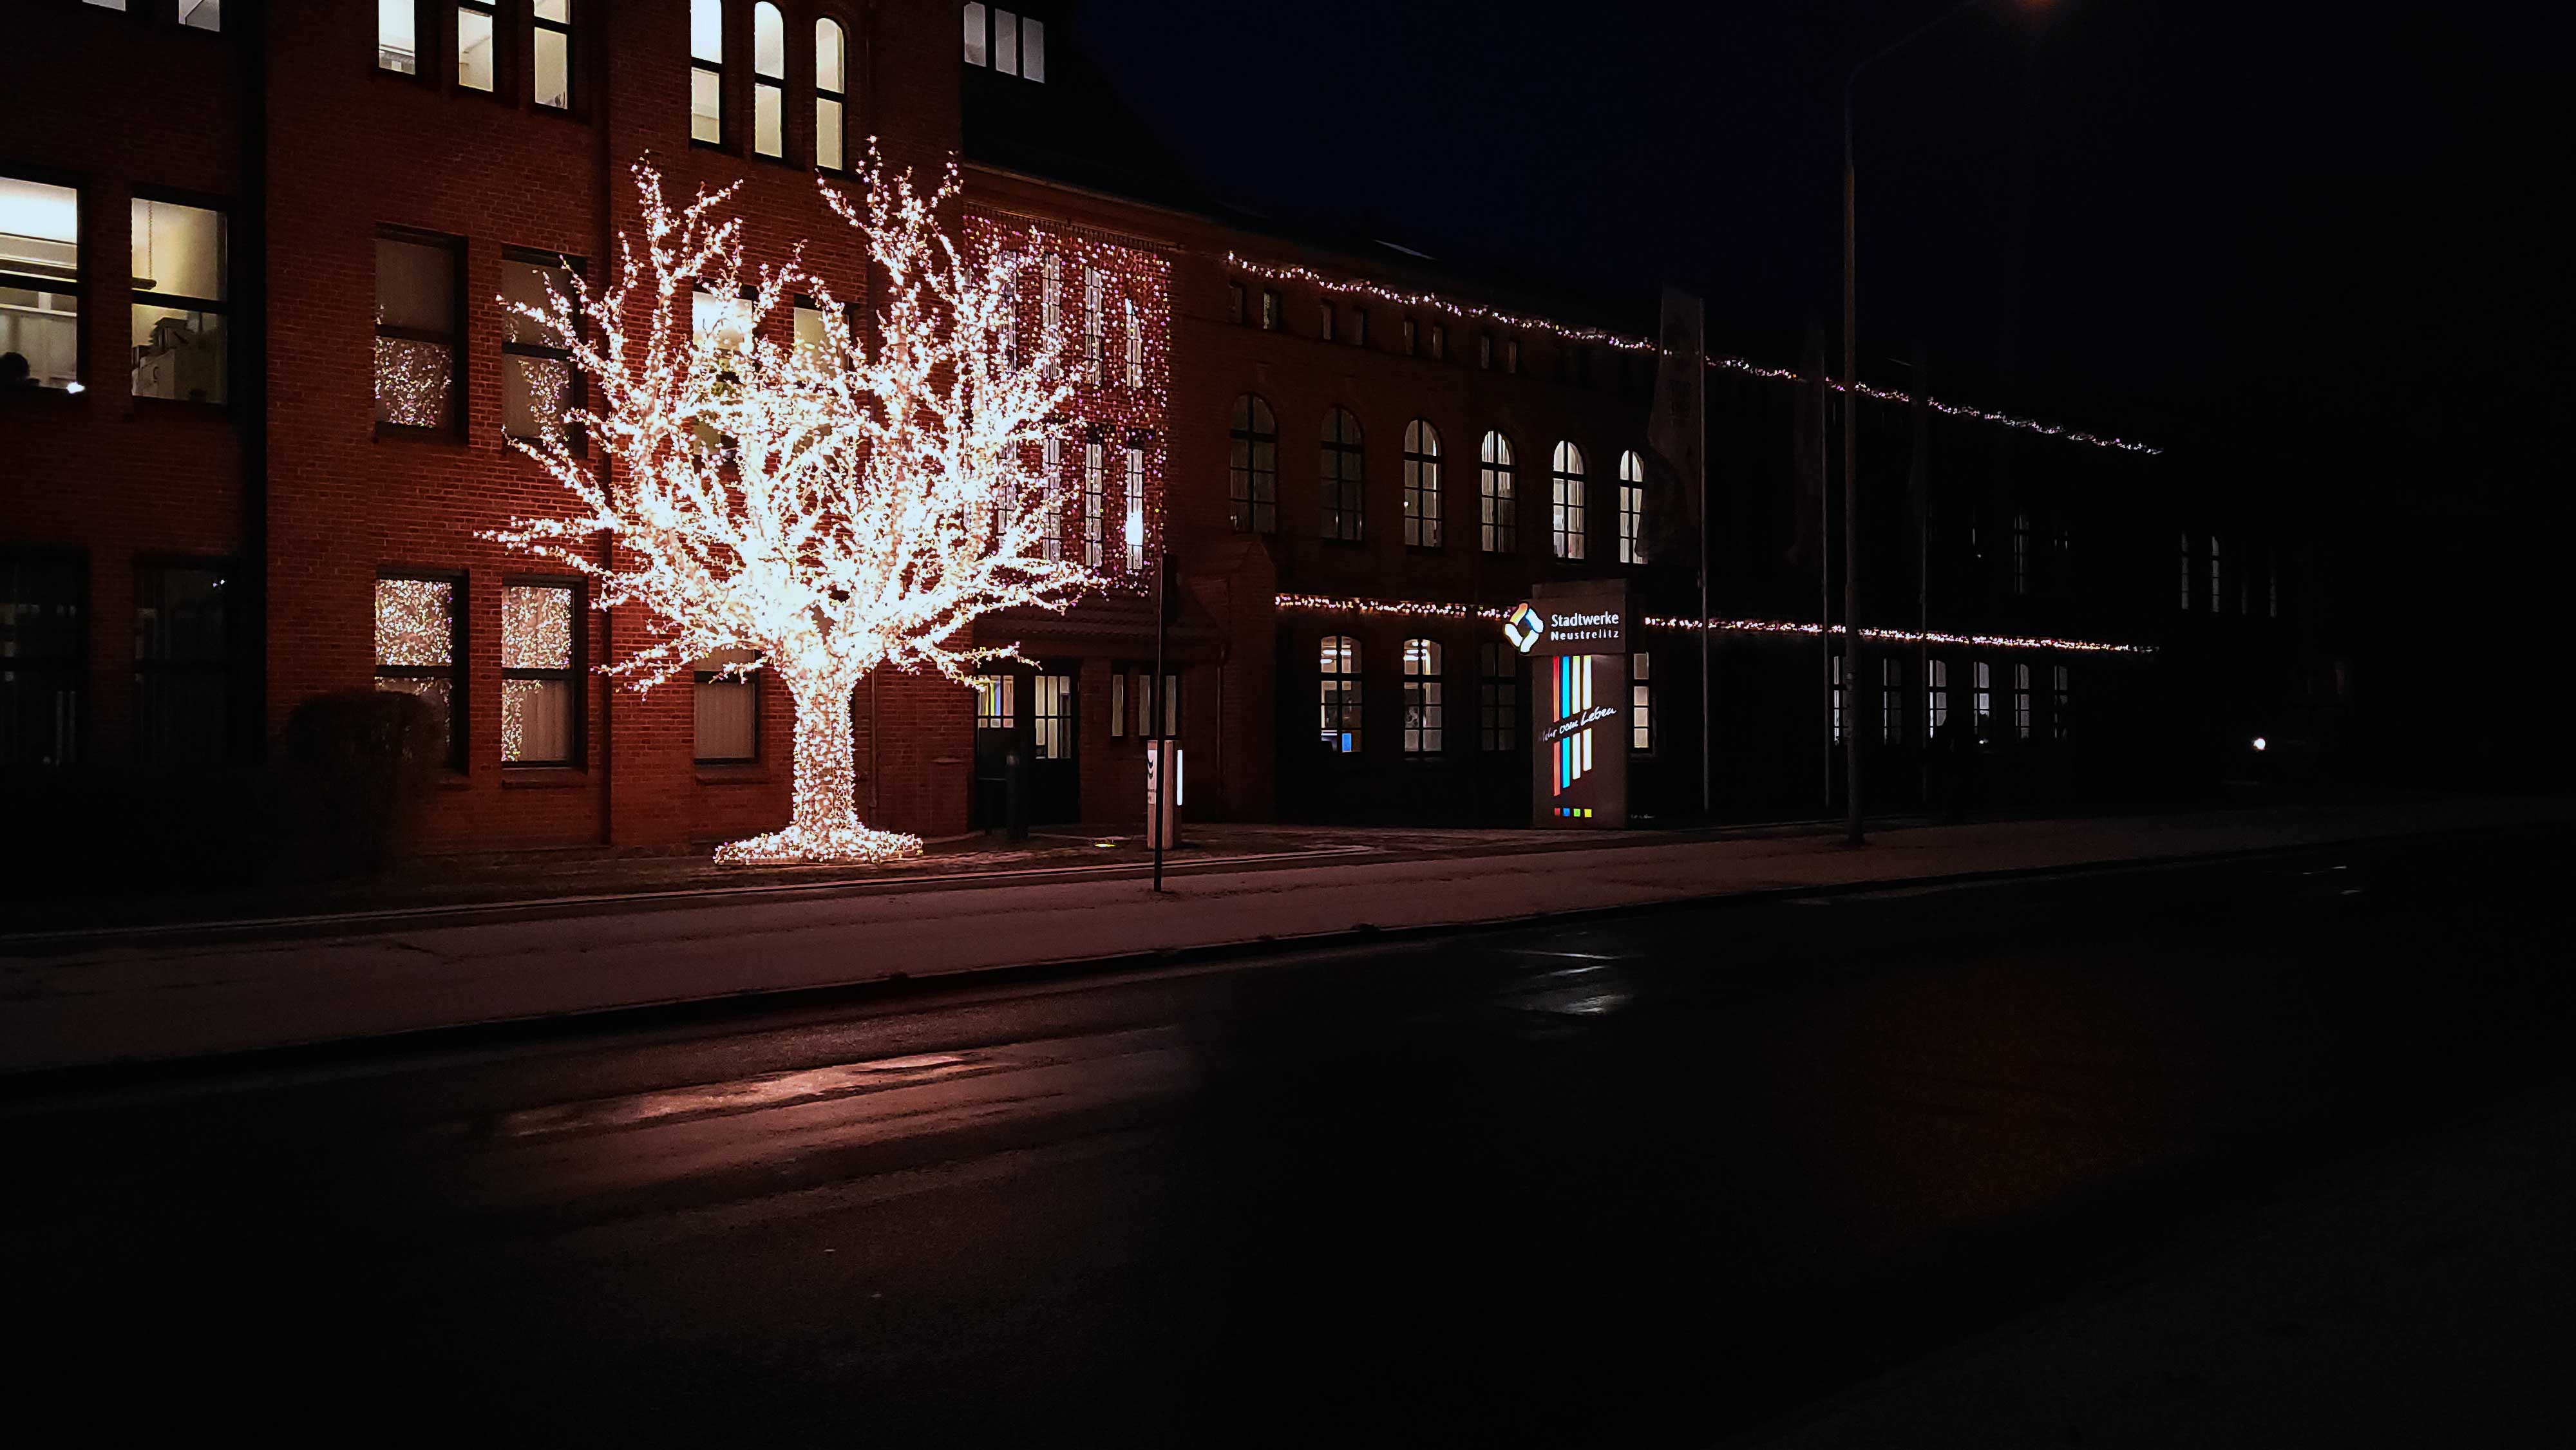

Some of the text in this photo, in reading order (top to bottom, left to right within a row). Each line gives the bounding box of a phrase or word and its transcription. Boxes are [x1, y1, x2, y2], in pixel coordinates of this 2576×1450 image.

[1551, 610, 1620, 628] Stadtwerke
[1550, 628, 1620, 641] Neustrelitz
[1580, 706, 1617, 726] Leben
